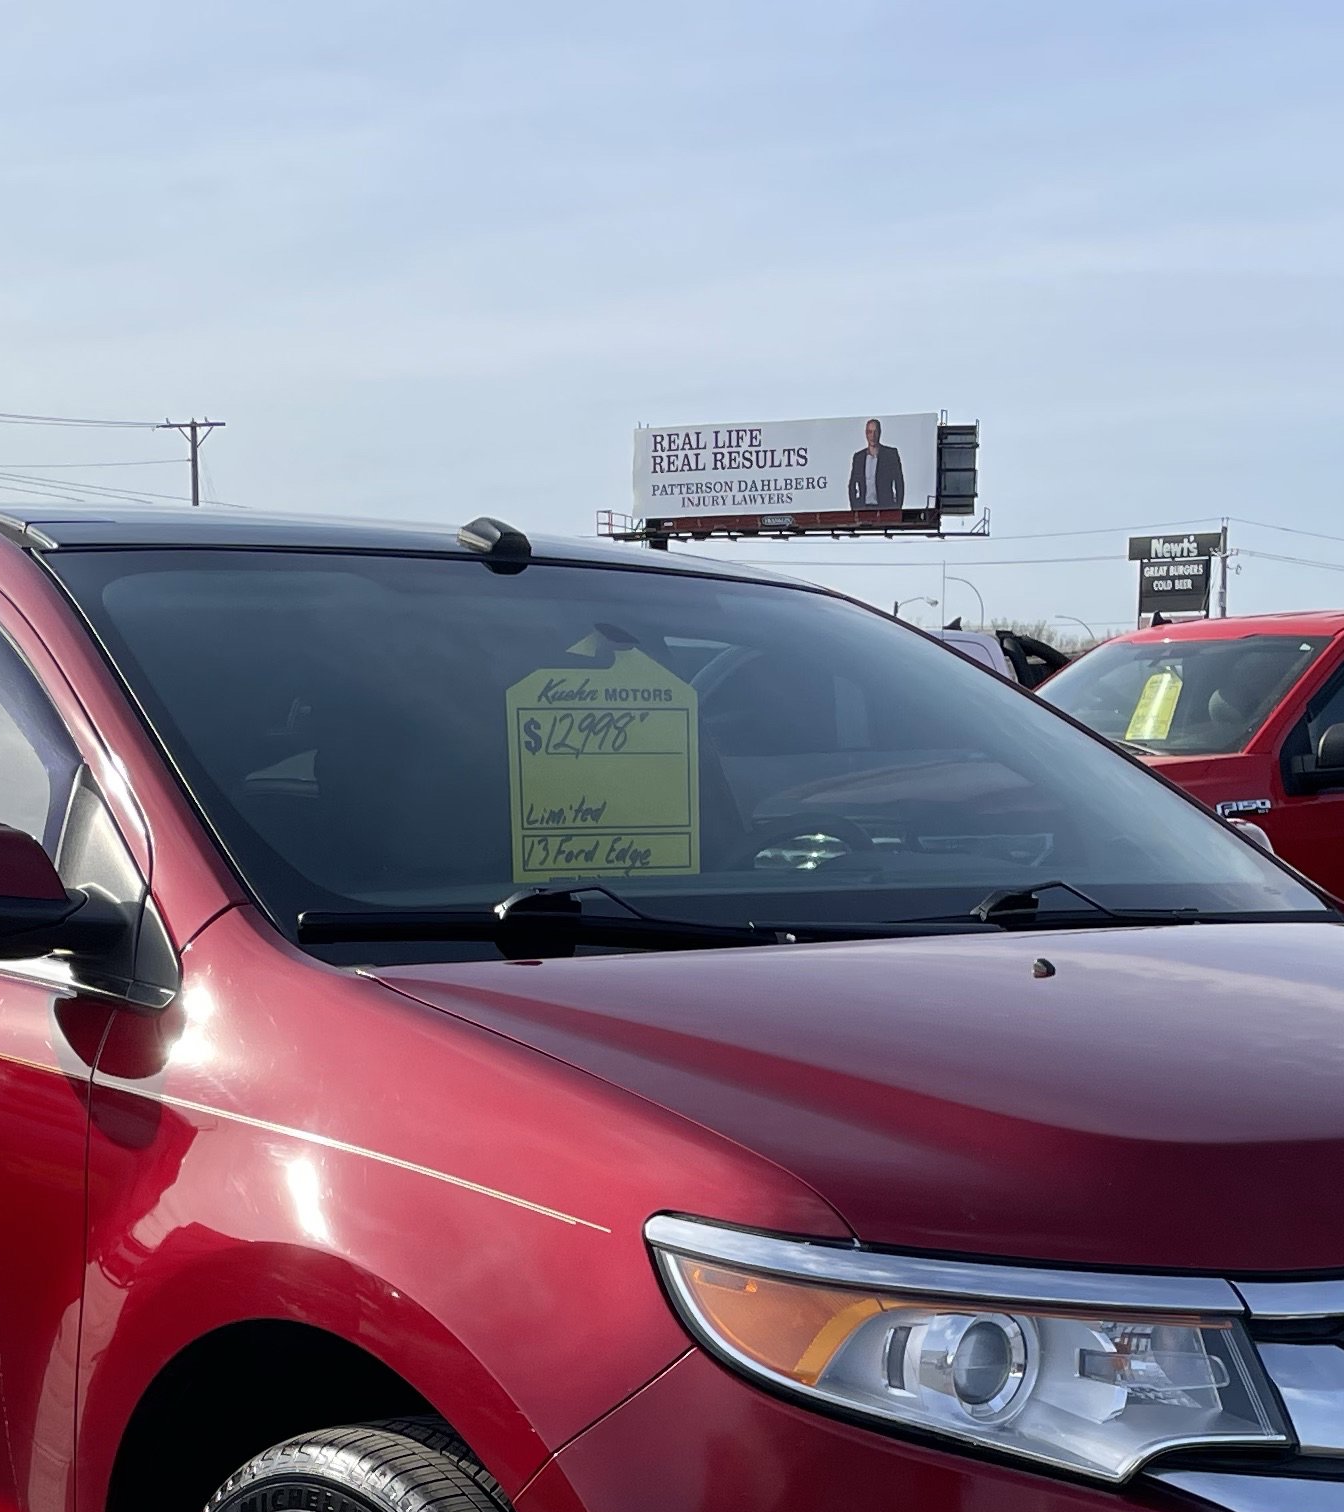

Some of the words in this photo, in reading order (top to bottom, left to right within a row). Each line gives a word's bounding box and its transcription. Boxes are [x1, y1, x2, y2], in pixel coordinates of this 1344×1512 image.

[652, 431, 707, 453] REAL
[713, 429, 763, 449] LIFE
[651, 453, 706, 474] REAL
[712, 448, 809, 471] RESULTS
[651, 481, 734, 497] PATTERSON
[737, 476, 829, 493] DAHLBERG
[681, 496, 729, 509] INJURY
[732, 492, 794, 507] LAWYERS
[1150, 535, 1198, 558] Newt's
[1143, 566, 1168, 577] GREAT
[1169, 564, 1204, 576] BURGERS
[1152, 580, 1173, 591] COLD
[1174, 579, 1193, 590] BEER
[537, 678, 599, 704] Kuehn
[604, 688, 673, 702] MOTORS
[525, 796, 607, 826] Limited
[553, 835, 600, 866] Ford
[604, 836, 652, 878] Edge
